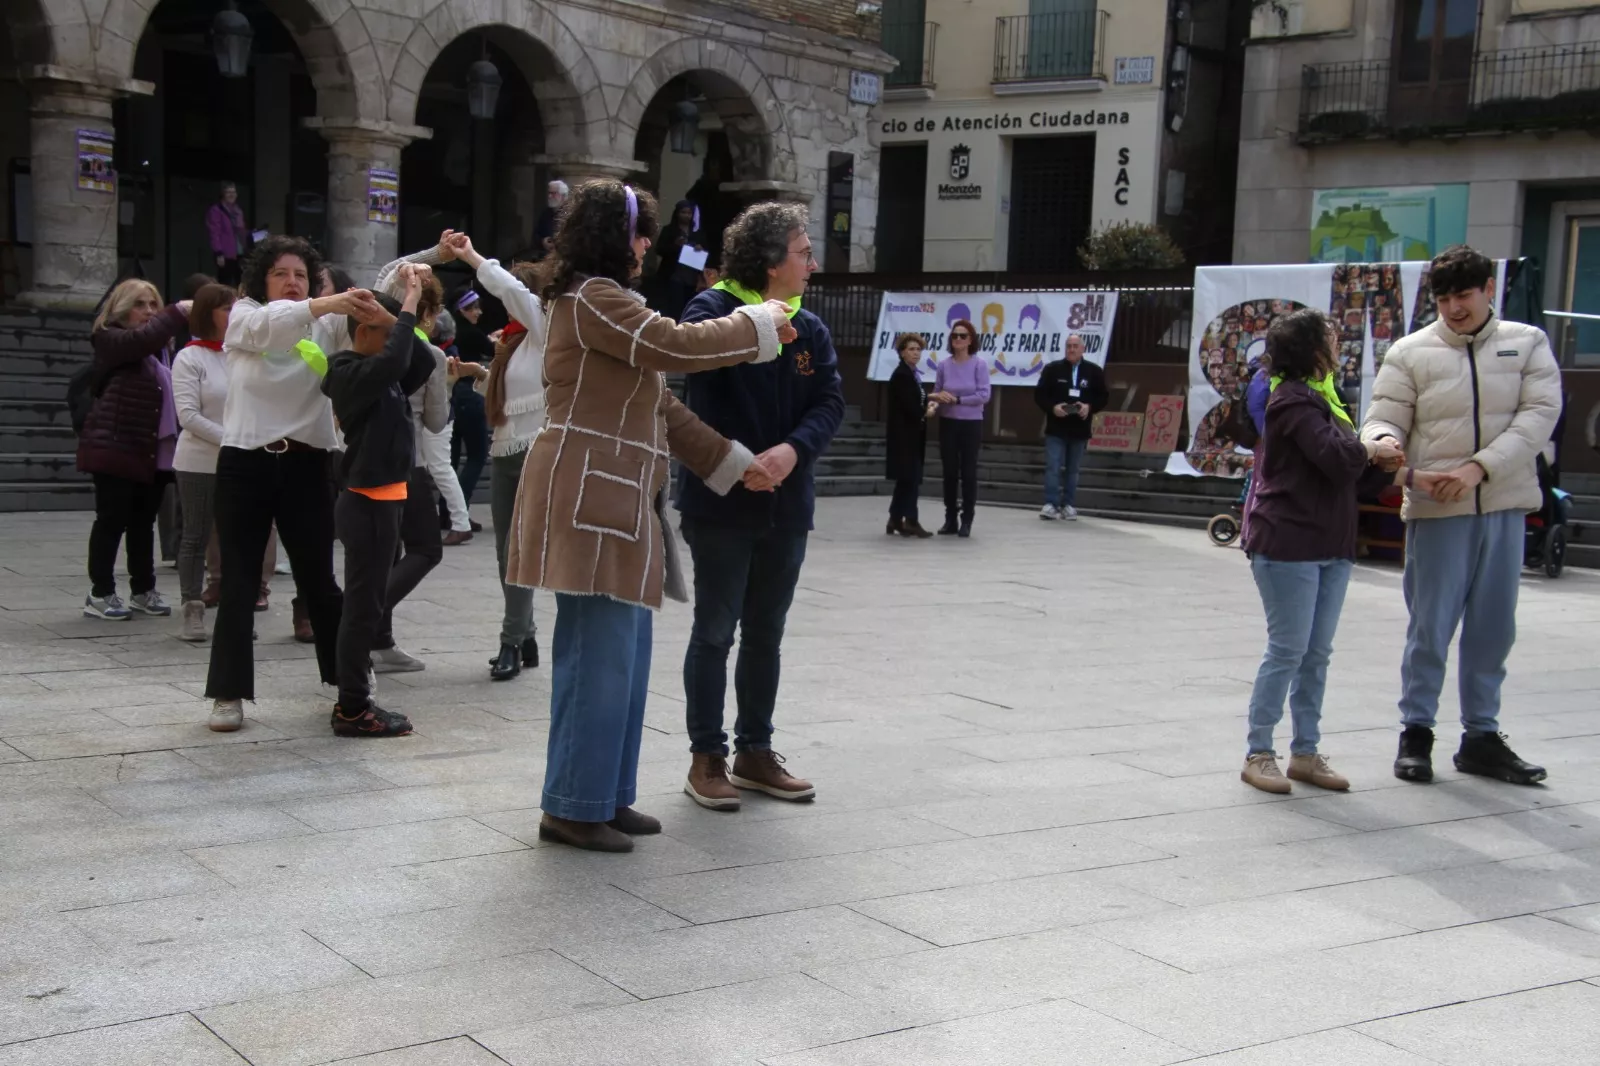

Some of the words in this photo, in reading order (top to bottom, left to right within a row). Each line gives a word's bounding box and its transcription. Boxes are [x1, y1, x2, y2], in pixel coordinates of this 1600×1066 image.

[1119, 70, 1149, 81] MAYOR
[914, 116, 936, 132] de
[942, 113, 1022, 131] Atención
[1029, 110, 1130, 127] Ciudadana
[938, 182, 982, 194] Monzón
[879, 331, 890, 349] SI
[1002, 333, 1016, 353] SE
[1018, 333, 1047, 353] PARA
[1050, 333, 1061, 353] EL
